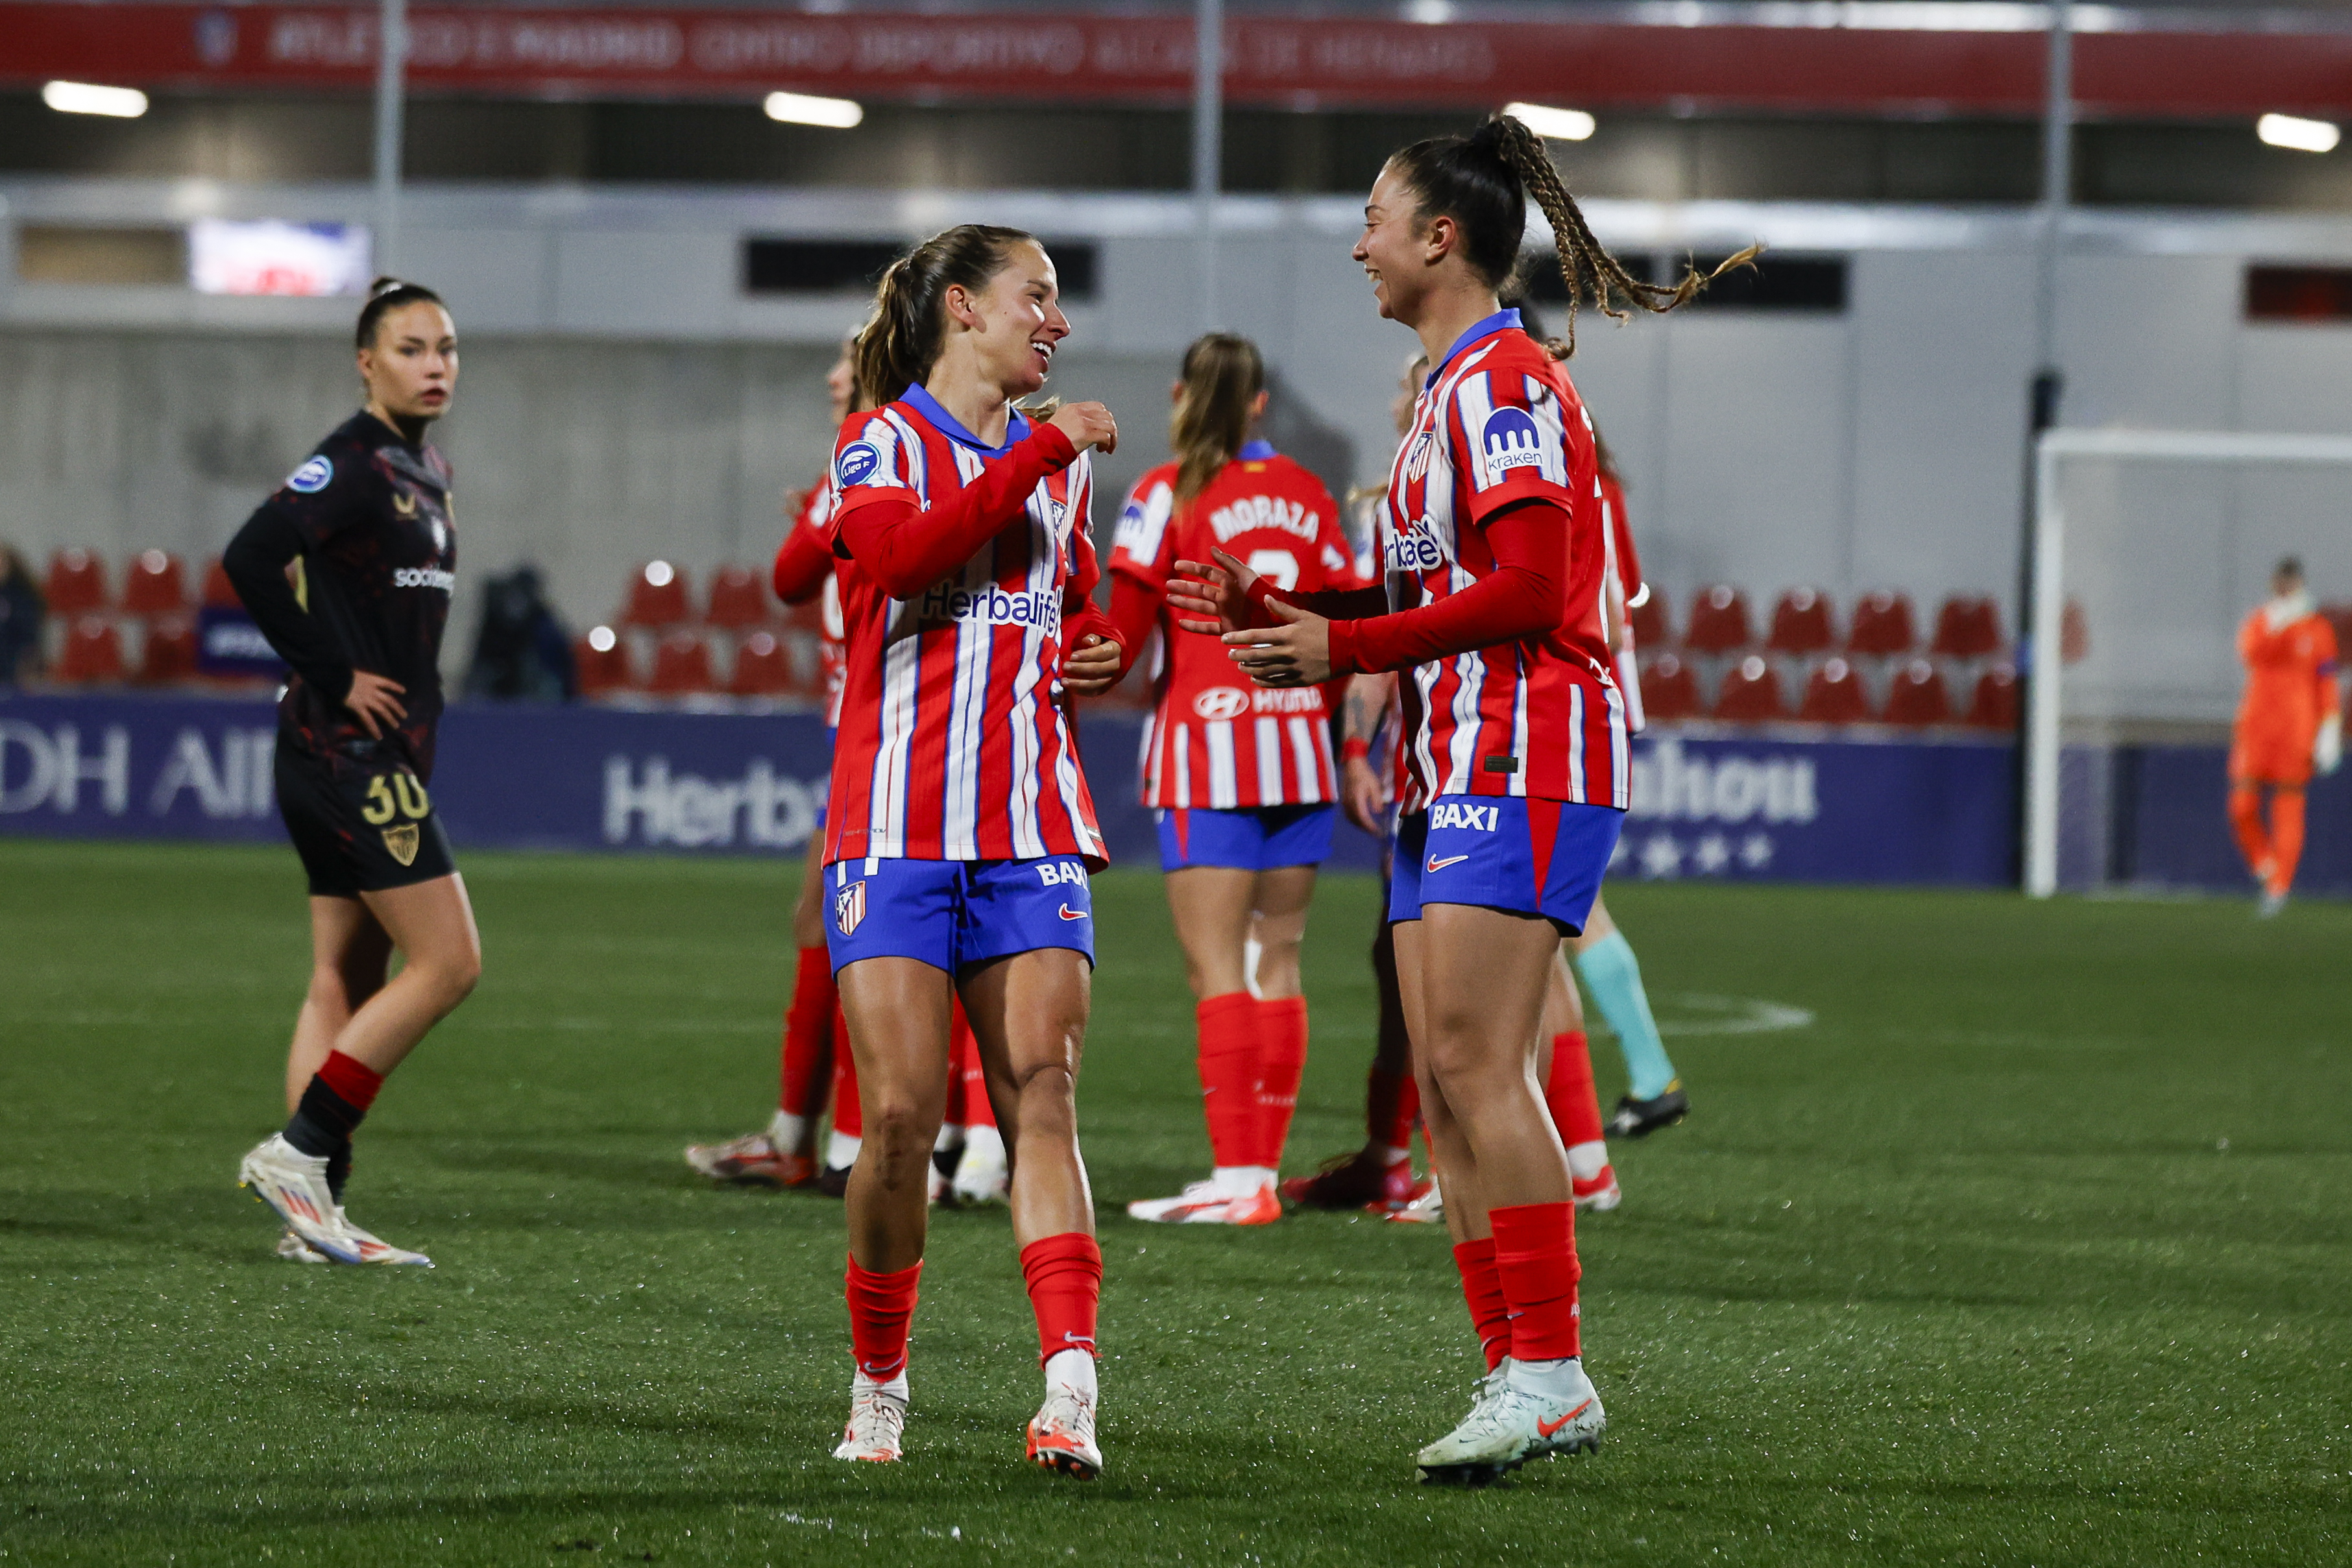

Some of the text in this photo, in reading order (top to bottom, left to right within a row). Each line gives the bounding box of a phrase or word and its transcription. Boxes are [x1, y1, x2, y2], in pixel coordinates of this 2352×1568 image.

[844, 463, 862, 477] Liga
[1488, 452, 1543, 471] kraken
[1209, 494, 1320, 544] MORAZA
[602, 754, 832, 847] Herb
[1431, 803, 1499, 832] BAXI
